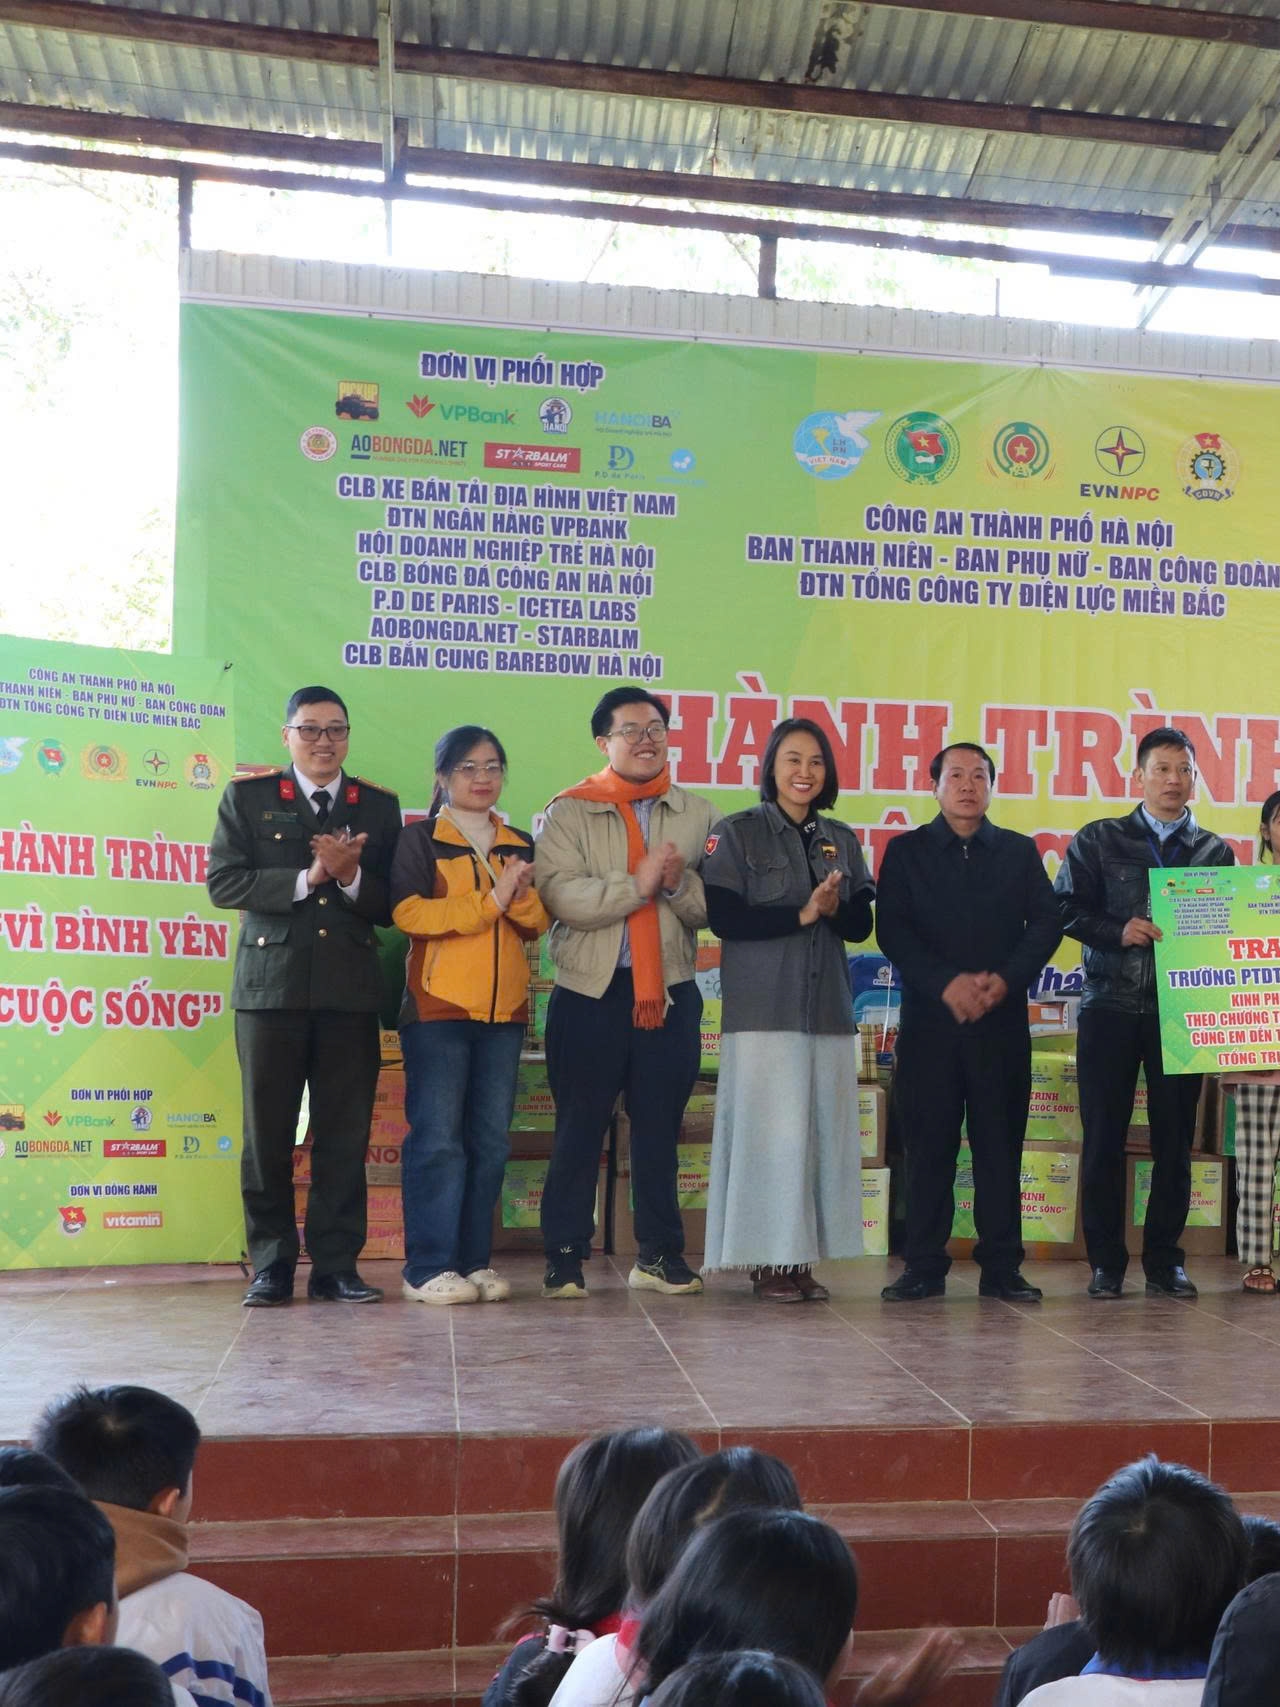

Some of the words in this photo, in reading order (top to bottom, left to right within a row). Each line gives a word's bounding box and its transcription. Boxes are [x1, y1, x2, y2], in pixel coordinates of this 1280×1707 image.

[421, 352, 467, 379] ĐƠN
[473, 356, 496, 384] VỊ
[502, 356, 553, 384] PHỐI
[560, 361, 603, 391] HỢP
[440, 404, 516, 425] VPBank
[351, 434, 467, 457] AOBONGDA.NET
[339, 475, 375, 497] CLB
[382, 478, 404, 499] XE
[411, 478, 450, 502] BÁN
[457, 480, 487, 504] TẢI
[494, 485, 527, 507] ĐỊA
[534, 486, 580, 510] HÌNH
[587, 489, 628, 516] VIỆT
[633, 493, 675, 515] NAM
[387, 506, 426, 528] ĐTN
[433, 508, 485, 532] NGÂN
[492, 512, 544, 535] HÀNG
[550, 516, 627, 539] VPBANK
[865, 504, 926, 533] CÔNG
[933, 510, 963, 535] AN
[970, 512, 1042, 540] THÀNH
[1050, 512, 1093, 542] PHỐ
[1101, 518, 1129, 544] HÀ
[1136, 520, 1172, 551] NỘI
[358, 532, 393, 557] HỘI
[400, 535, 466, 558] DOANH
[473, 539, 543, 562] NGHIỆP
[549, 543, 583, 564] TRẺ
[589, 543, 615, 566] HÀ
[621, 545, 653, 570] NỘI
[748, 535, 793, 561] BAN
[800, 538, 875, 566] THANH
[883, 541, 932, 569] NIÊN
[955, 547, 999, 572] BAN
[1007, 550, 1050, 579] PHỤ
[1058, 551, 1088, 577] NỮ
[1109, 556, 1156, 579] BAN
[1159, 556, 1217, 584] CÔNG
[1224, 561, 1280, 587] ĐOÀN
[360, 561, 396, 582] CLB
[403, 561, 457, 585] BÓNG
[463, 565, 490, 587] ĐÁ
[496, 566, 549, 590] CÔNG
[555, 571, 580, 592] AN
[587, 570, 613, 593] HÀ
[619, 571, 651, 595] NỘI
[800, 571, 844, 597] ĐTN
[851, 570, 910, 600] TỔNG
[918, 575, 978, 604] CÔNG
[986, 581, 1012, 605] TY
[1019, 580, 1068, 612] ĐIỆN
[1076, 584, 1115, 613] LỰC
[1123, 582, 1175, 614] MIỀN
[1183, 589, 1224, 616] BẮC
[374, 589, 404, 610] P.D
[411, 591, 435, 612] DE
[441, 592, 499, 615] PARIS
[519, 597, 583, 619] ICETEA
[589, 600, 636, 622] LABS
[371, 617, 518, 644] AOBONGDA.NET
[537, 625, 638, 649] STARBALM
[62, 672, 75, 683] AN
[345, 643, 381, 665] CLB
[389, 643, 428, 667] BẮN
[435, 648, 488, 670] CUNG
[495, 650, 591, 674] BAREBOW
[597, 652, 622, 675] HÀ
[629, 654, 661, 680] NỘI
[73, 691, 92, 701] BAN
[145, 698, 165, 709] BAN
[89, 707, 100, 718] TY
[0, 906, 42, 948] VÌ
[55, 909, 148, 953] BÌNH
[159, 914, 227, 957] YÊN
[1169, 968, 1235, 987] TRƯỜNG
[0, 982, 92, 1031] CUỘC
[1187, 1014, 1216, 1026] THEO
[1229, 1031, 1245, 1042] EM
